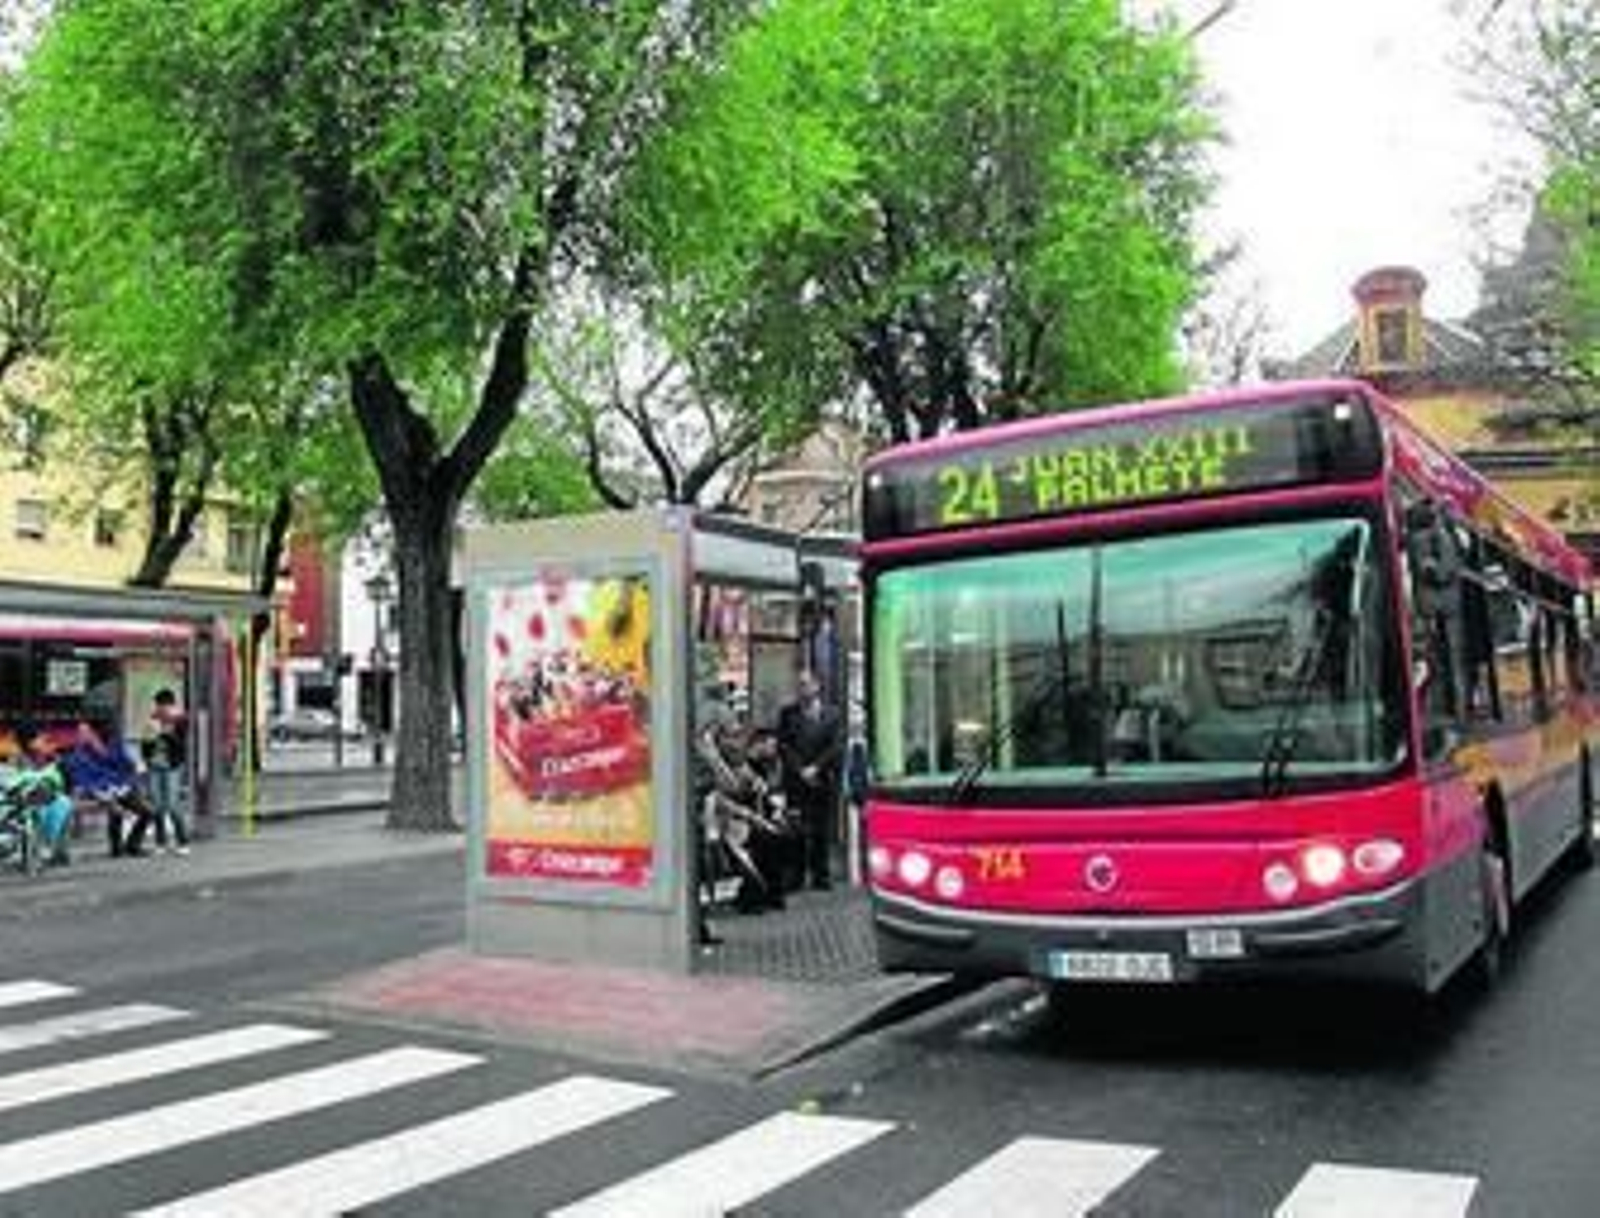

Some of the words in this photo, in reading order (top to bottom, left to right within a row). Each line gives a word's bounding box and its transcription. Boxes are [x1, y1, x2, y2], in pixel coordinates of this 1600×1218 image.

[1012, 448, 1117, 482] JUAN
[1037, 458, 1225, 510] PALMETE
[938, 462, 998, 524] 24
